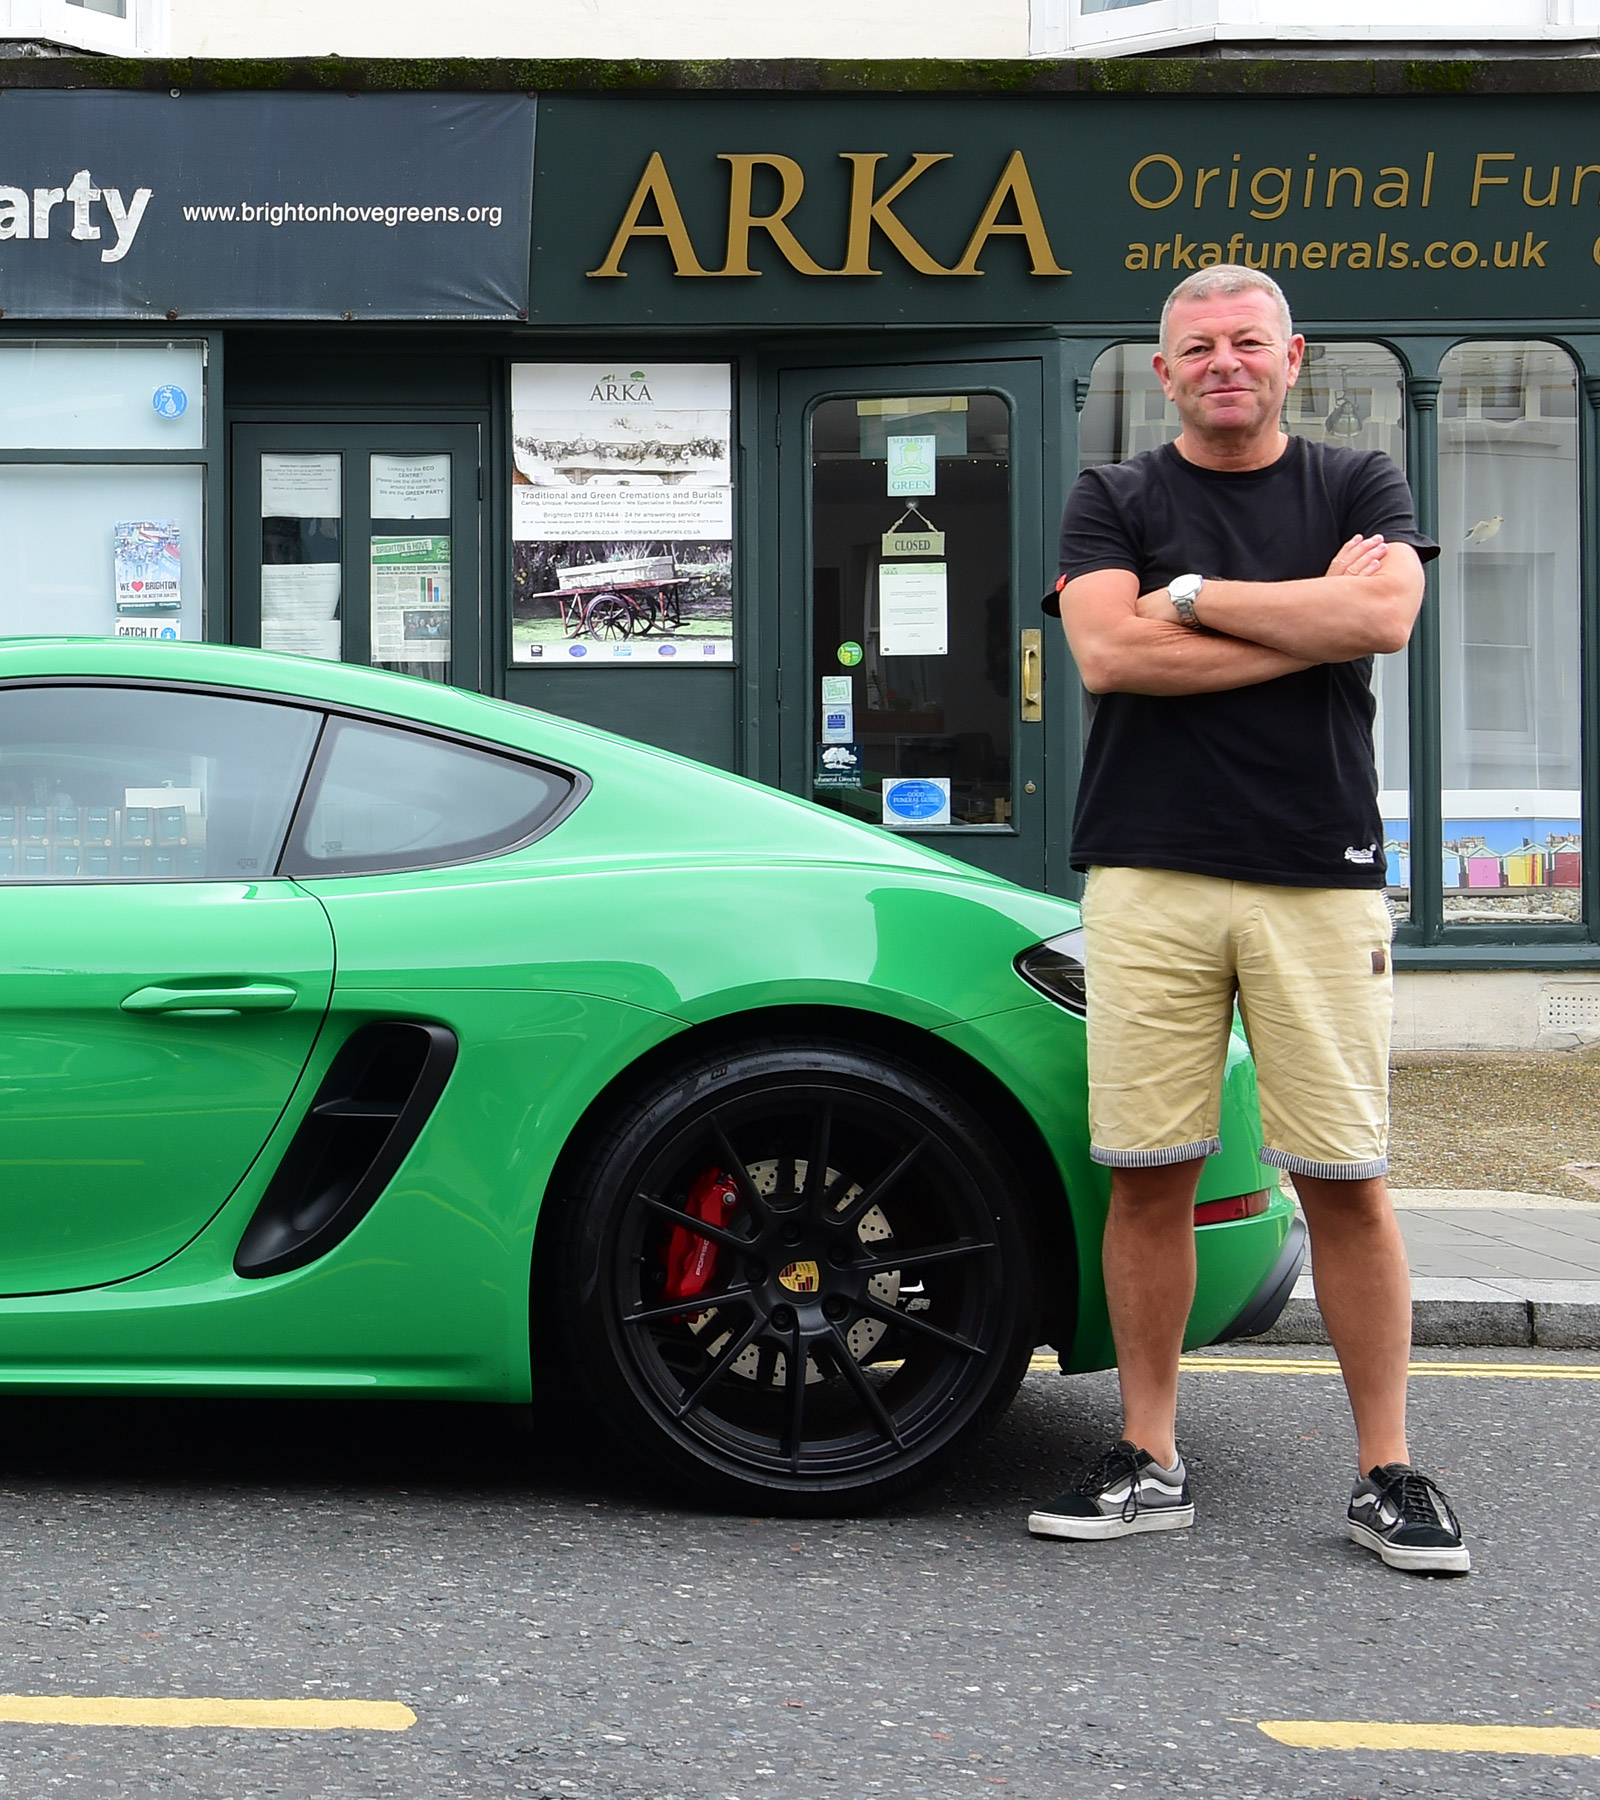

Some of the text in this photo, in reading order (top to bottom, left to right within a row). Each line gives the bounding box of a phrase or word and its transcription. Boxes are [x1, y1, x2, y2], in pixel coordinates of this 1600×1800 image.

[1129, 151, 1435, 220] Original
[182, 201, 503, 227] www.brightonhovegreens.org
[585, 148, 1072, 277] ARKA
[1124, 232, 1548, 270] arkafunerals.co.uk
[589, 384, 653, 401] ARKA
[892, 480, 931, 490] GREEN
[521, 491, 568, 499] Traditional
[570, 491, 587, 499] and
[590, 491, 617, 499] Green
[619, 491, 670, 499] Cremations
[376, 544, 406, 553] BRIGHTON
[412, 541, 431, 550] HOVE
[894, 540, 931, 551] CLOSED
[120, 581, 177, 591] WE BRIGHTON
[119, 626, 158, 638] CATCH IT
